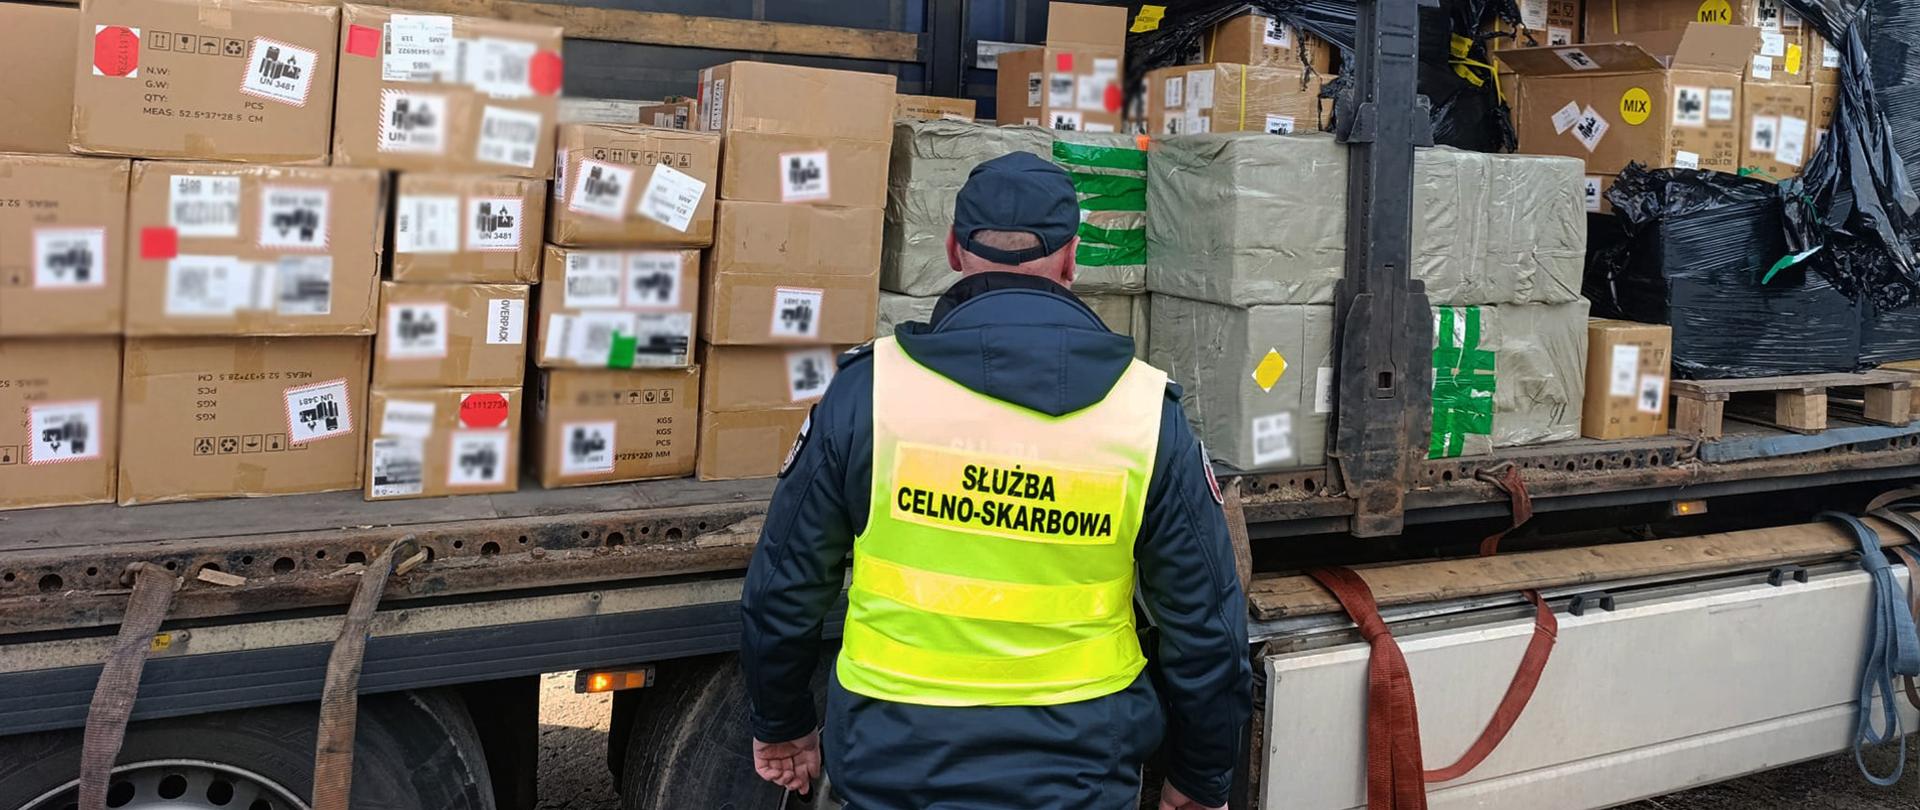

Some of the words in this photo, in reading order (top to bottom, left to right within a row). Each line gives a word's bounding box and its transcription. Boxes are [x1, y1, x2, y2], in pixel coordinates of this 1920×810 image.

[145, 79, 169, 89] G.W:
[260, 77, 272, 86] UN
[274, 80, 295, 91] 3481
[144, 93, 168, 102] QTY:
[244, 101, 264, 110] PCS
[1624, 99, 1647, 113] MIX
[248, 115, 263, 123] CM
[479, 231, 491, 239] UN
[499, 300, 510, 342] OVERPACK
[197, 387, 217, 395] PCS
[299, 397, 319, 405] 3481
[321, 393, 334, 401] UN
[196, 400, 217, 408] KGS
[462, 400, 508, 409] AL111273A
[195, 413, 216, 421] KGS
[656, 416, 672, 424] KGS
[656, 439, 671, 447] PCS
[962, 465, 1056, 502] SŁUŻBA
[898, 487, 1112, 537] CELNO-SKARBOWA
